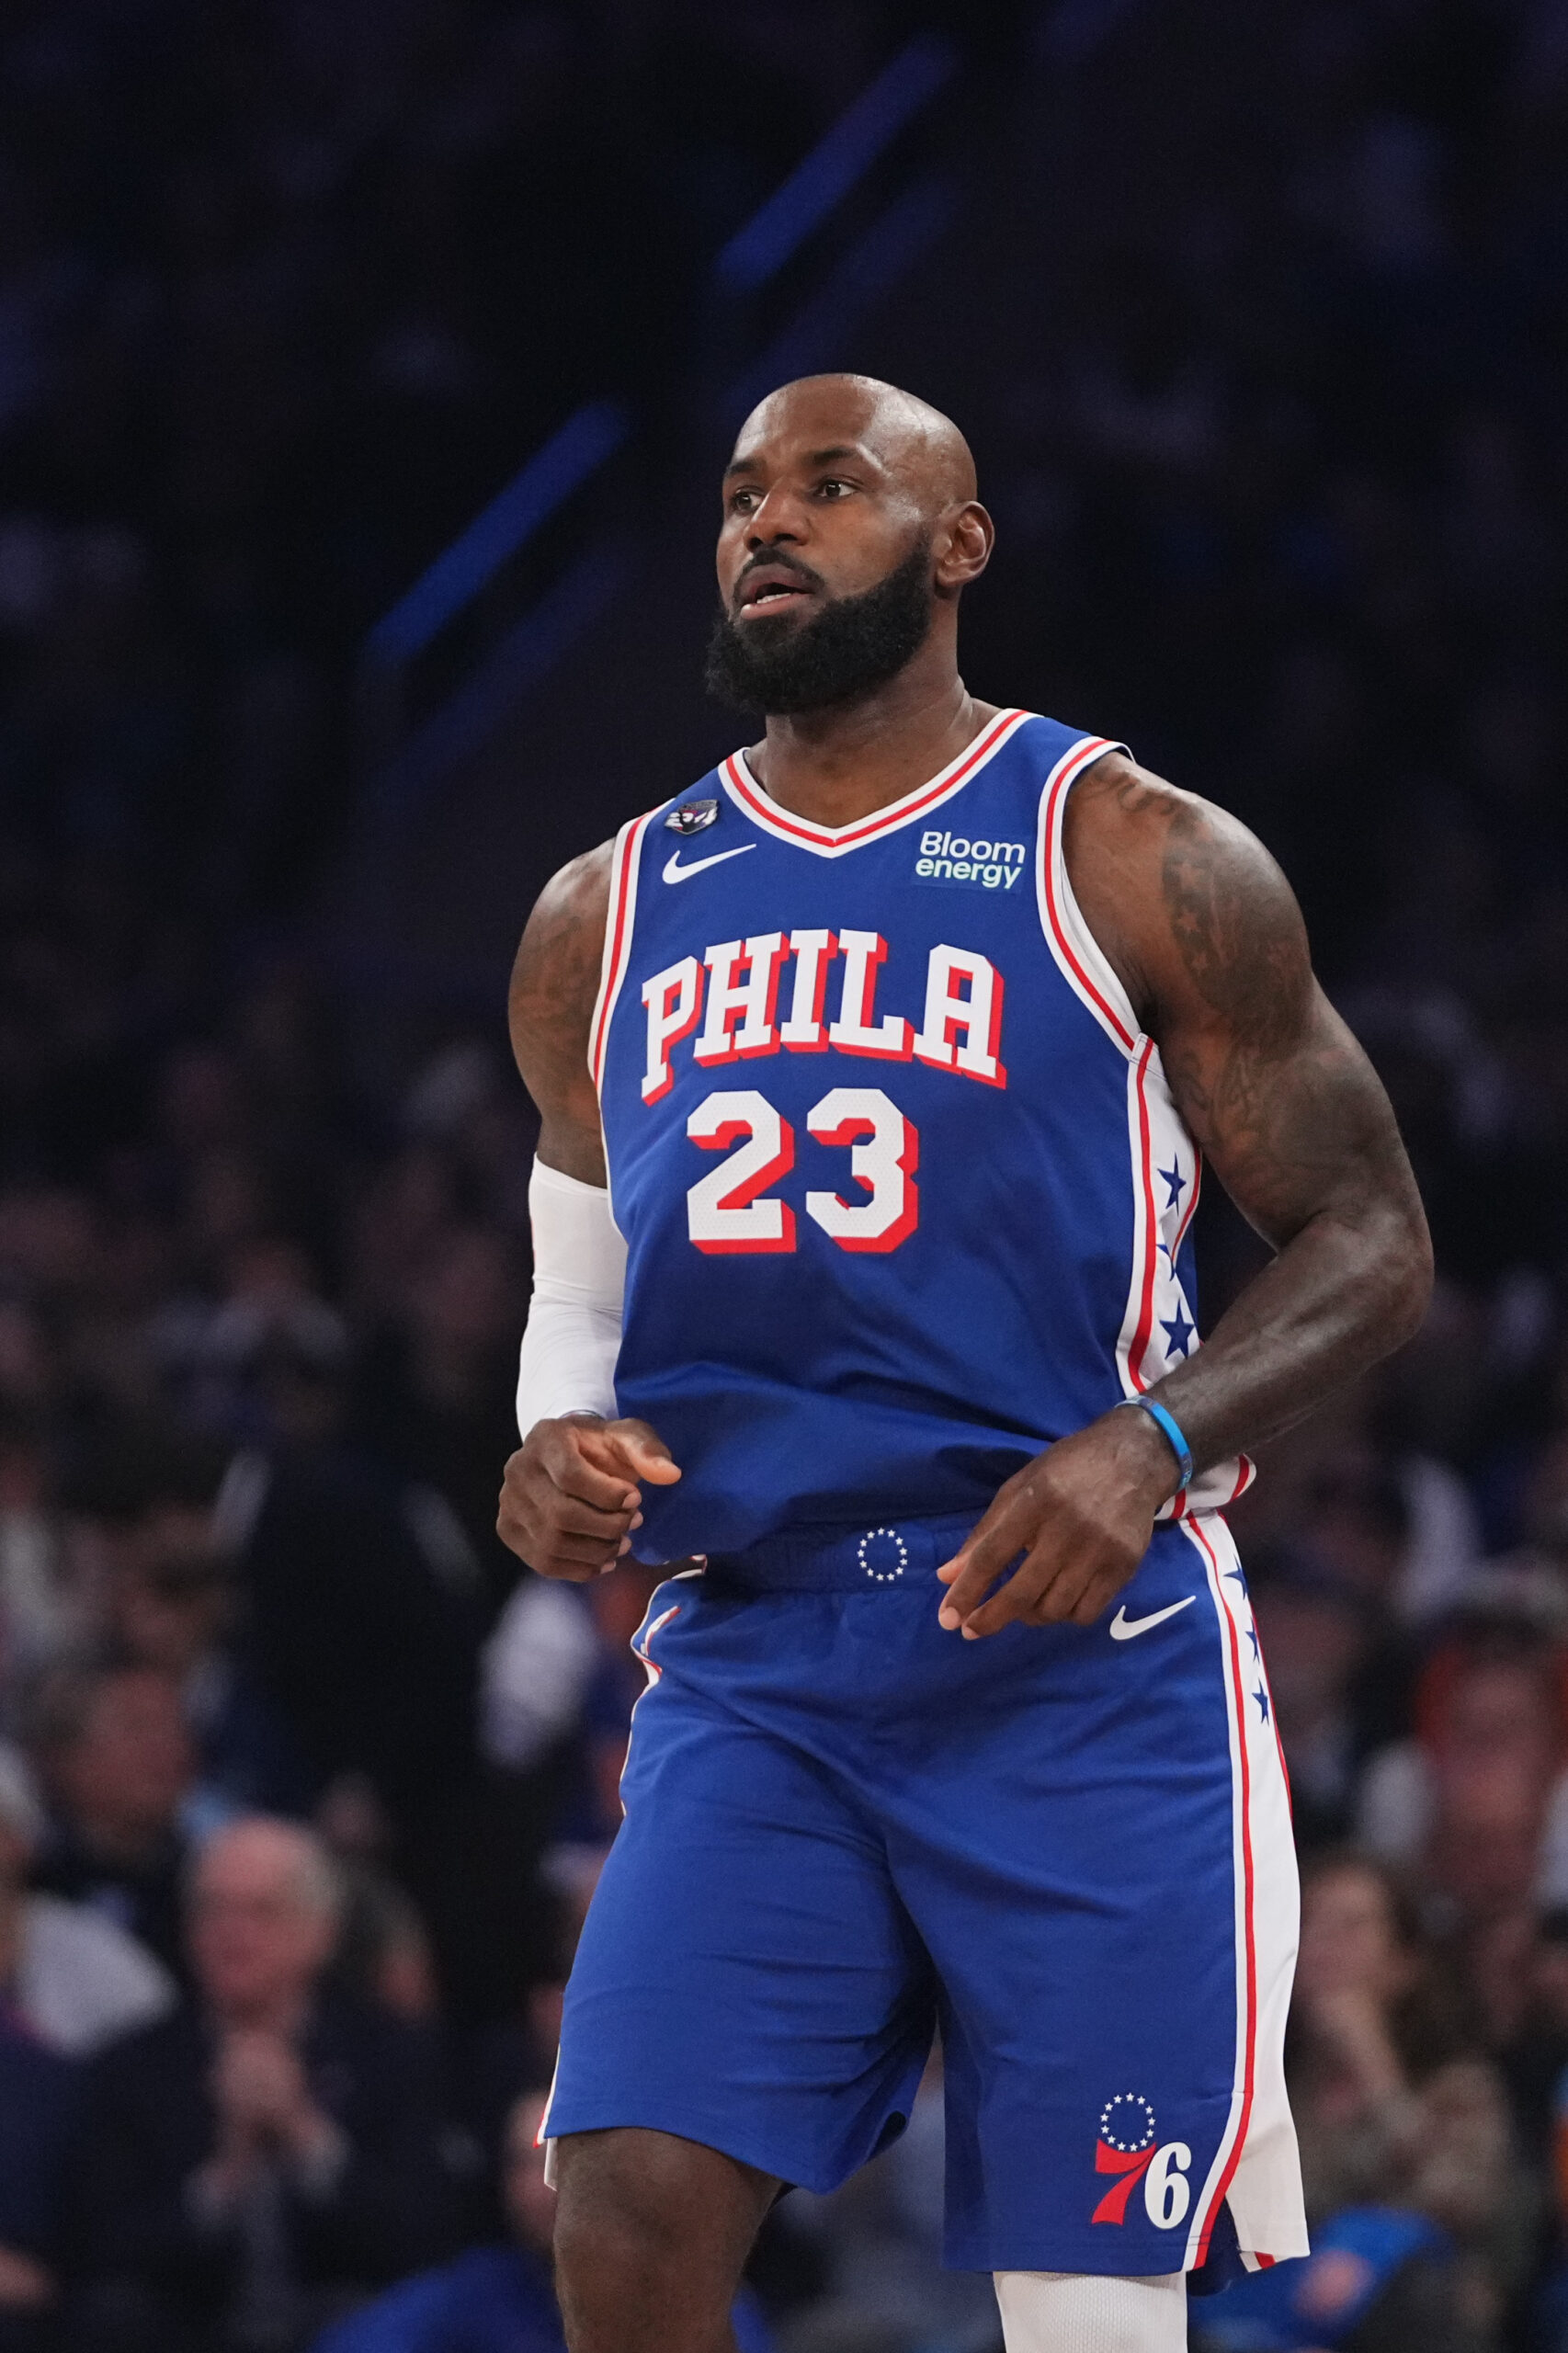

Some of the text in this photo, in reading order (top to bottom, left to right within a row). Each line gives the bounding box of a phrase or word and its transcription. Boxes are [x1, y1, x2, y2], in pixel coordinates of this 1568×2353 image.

[915, 858, 1022, 889] energy
[920, 831, 1026, 864] Bloom
[642, 928, 1006, 1107] PHILA
[687, 1087, 918, 1254] 23
[1091, 2139, 1192, 2229] 76
